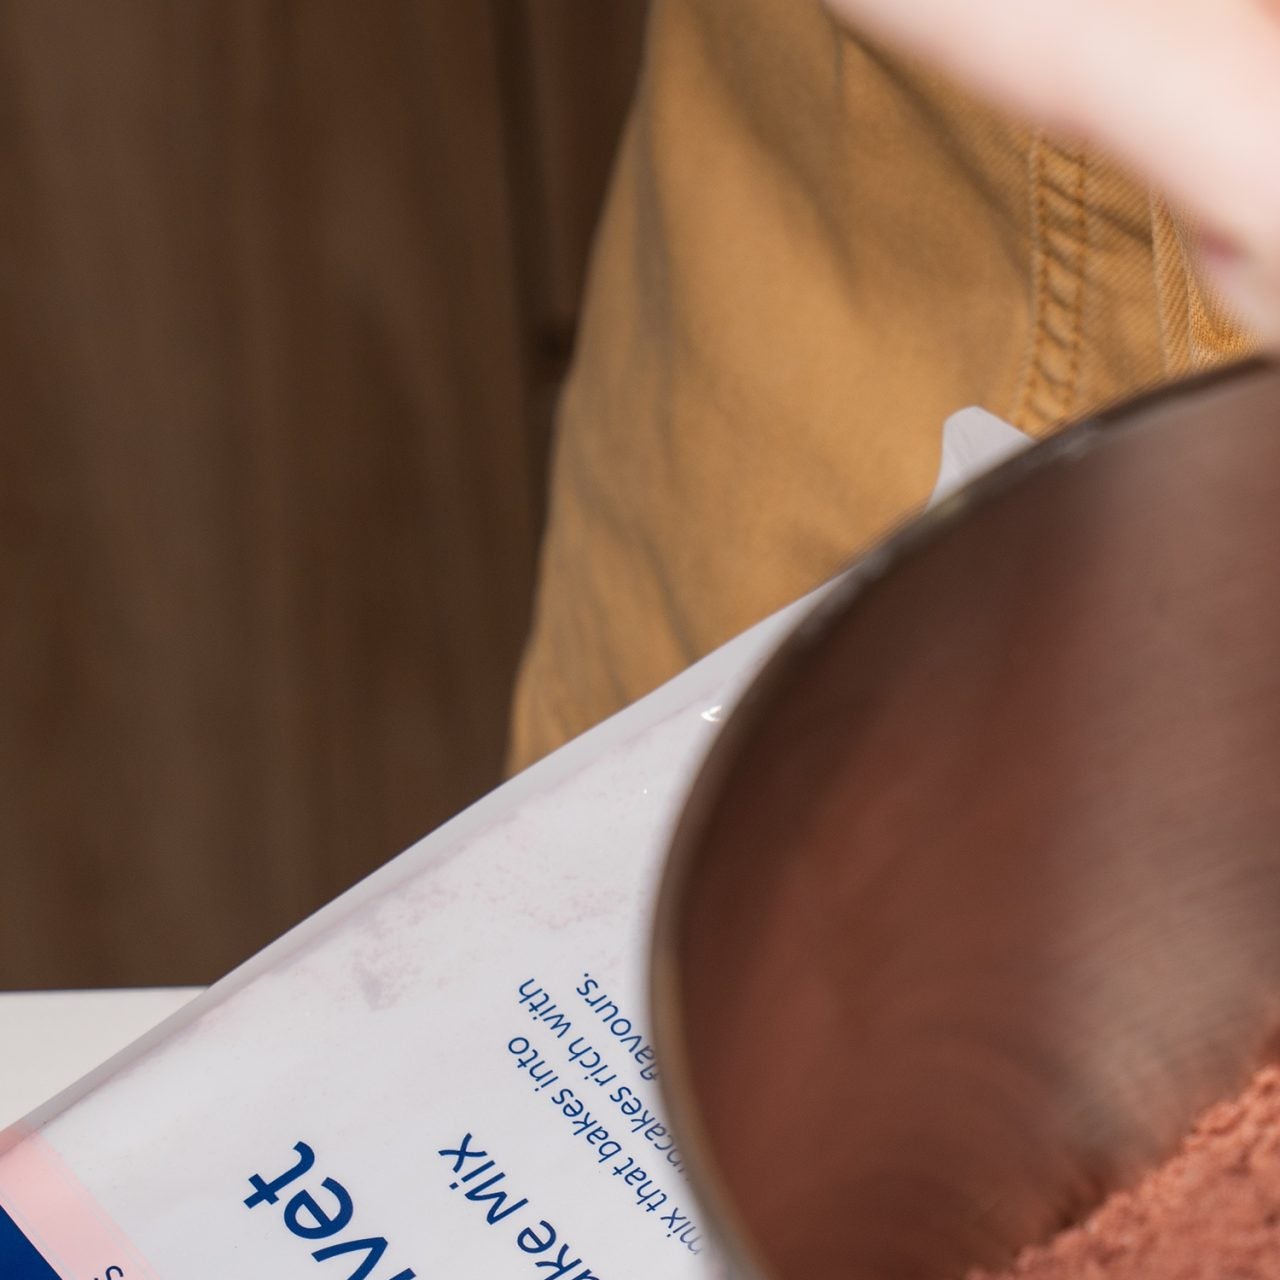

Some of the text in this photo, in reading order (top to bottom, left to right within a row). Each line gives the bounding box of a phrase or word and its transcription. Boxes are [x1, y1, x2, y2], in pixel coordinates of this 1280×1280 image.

[518, 978, 572, 1039] with
[508, 1036, 559, 1092] into
[567, 1036, 617, 1087] rich
[551, 1088, 622, 1164] bakes
[437, 1132, 530, 1226] Mix
[612, 1156, 668, 1212] that
